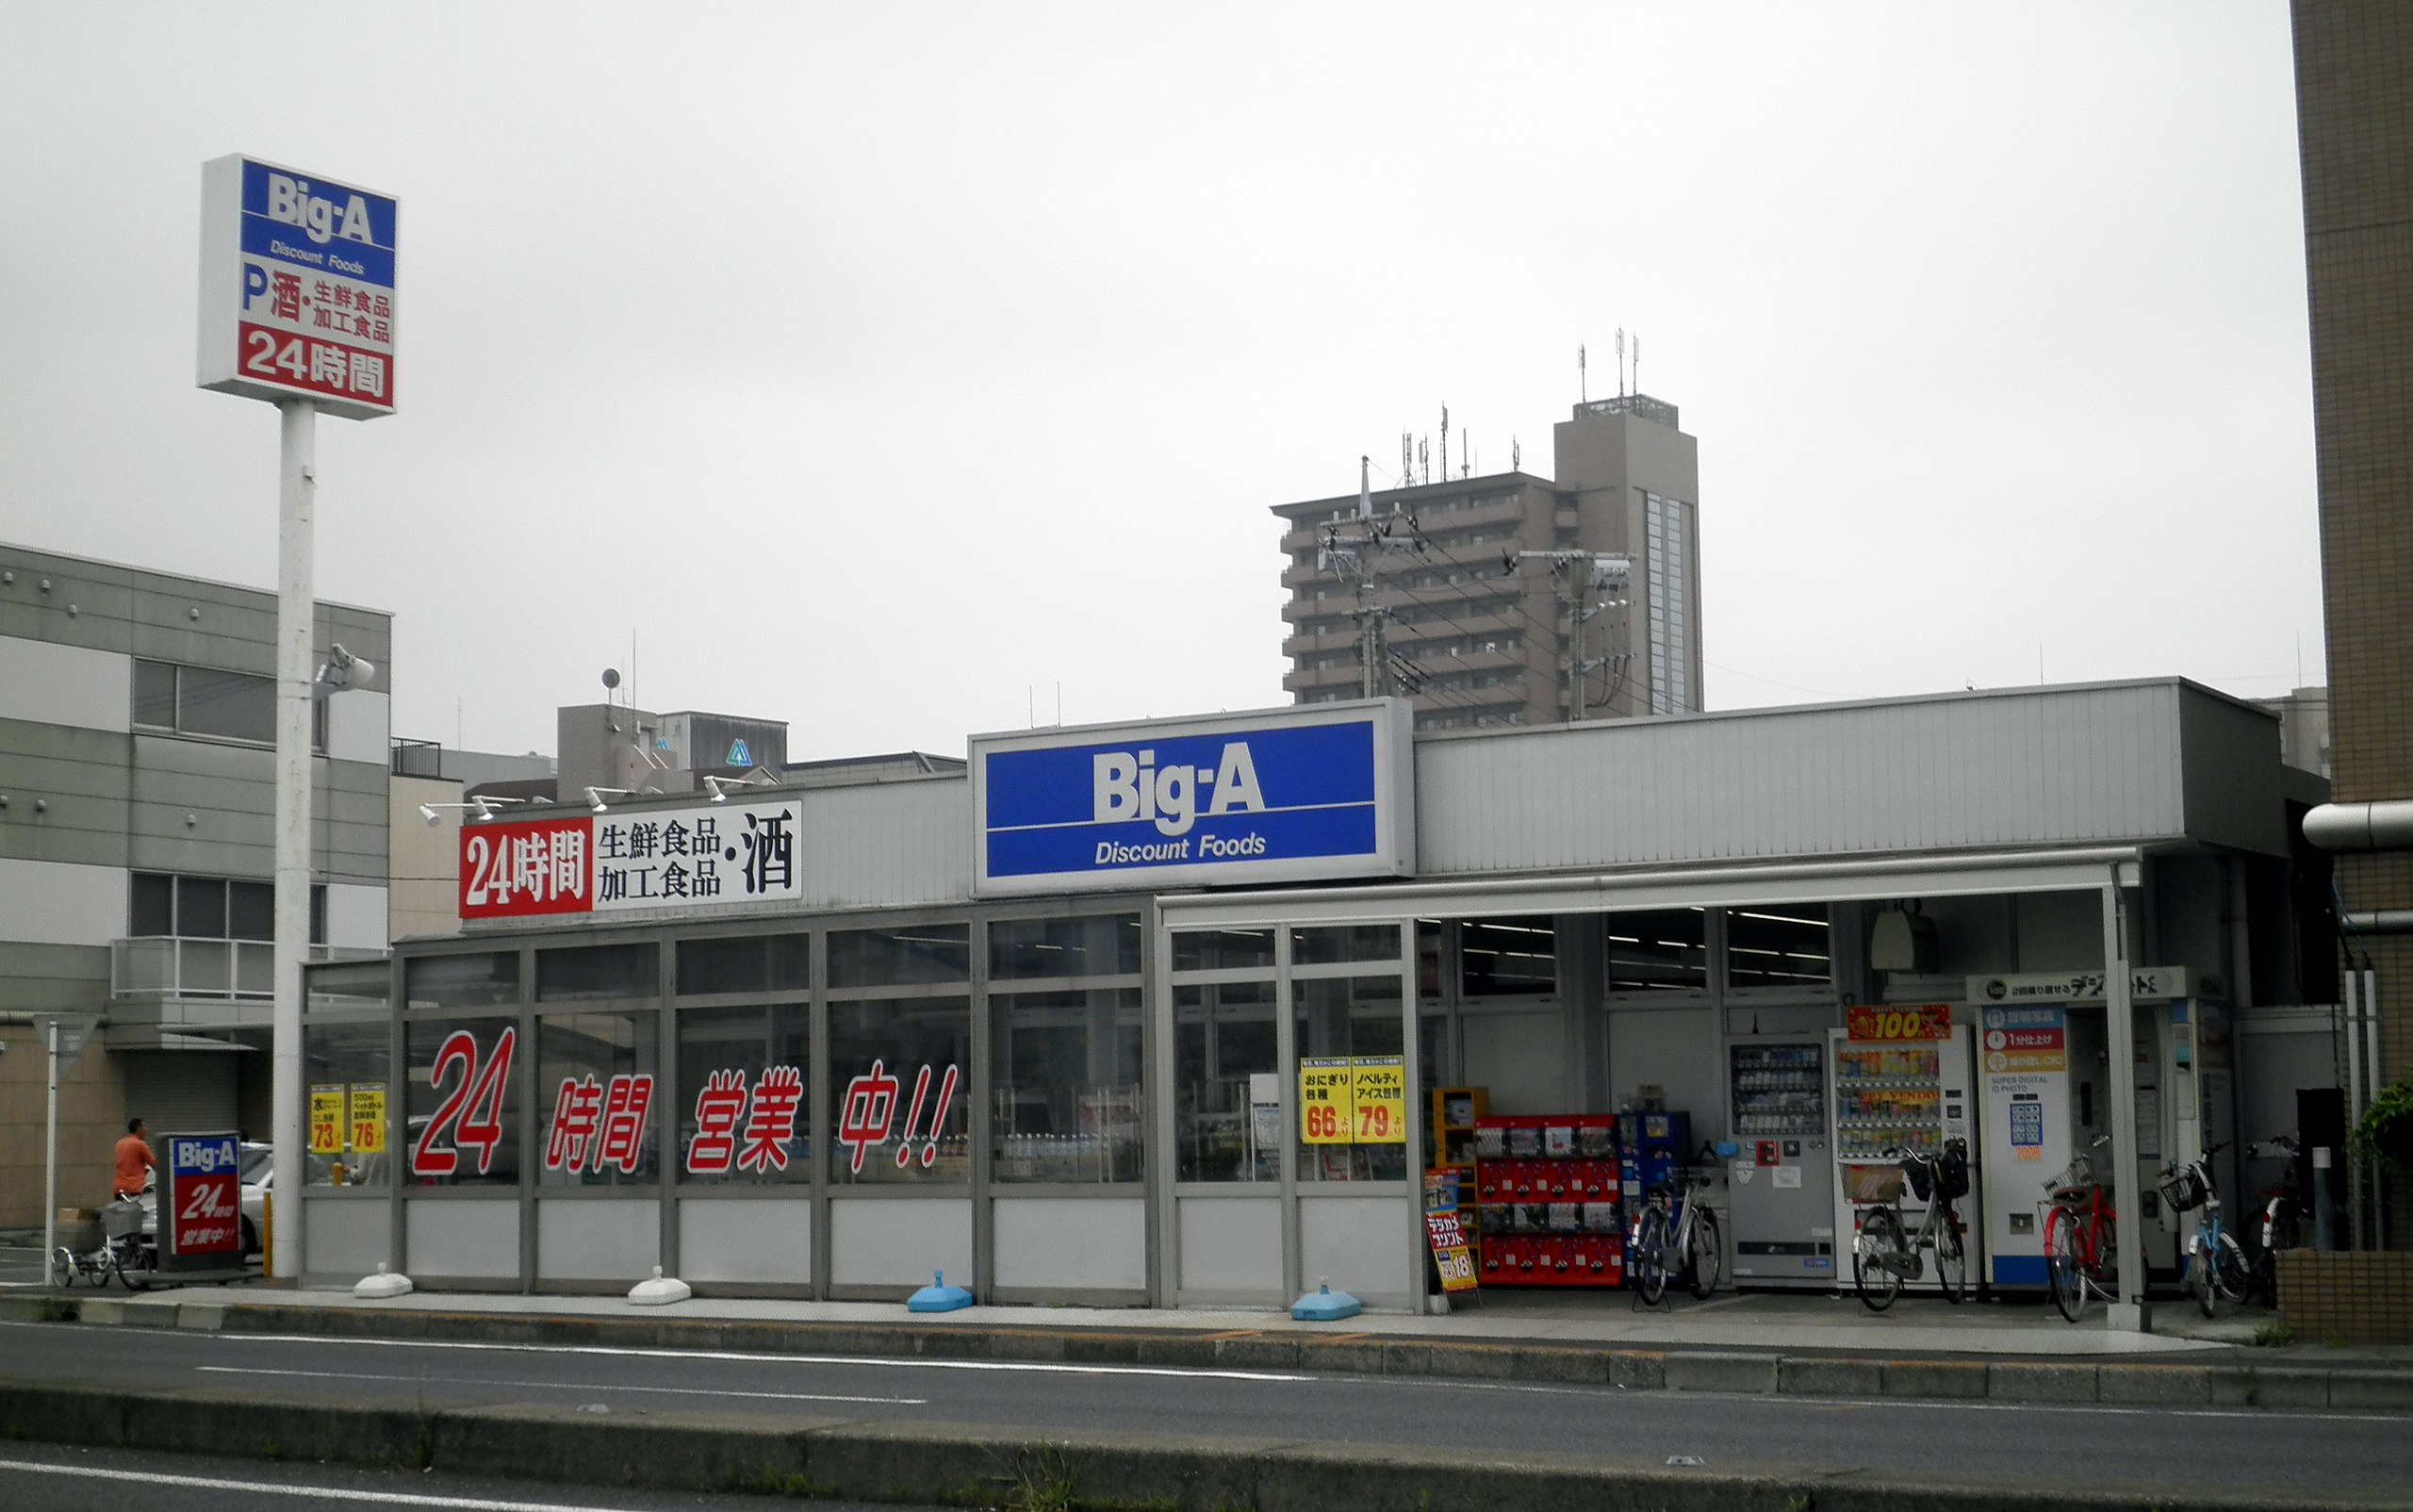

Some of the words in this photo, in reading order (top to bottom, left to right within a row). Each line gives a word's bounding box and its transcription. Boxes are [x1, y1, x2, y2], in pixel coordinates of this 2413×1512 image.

[268, 172, 372, 244] Big-A
[271, 239, 322, 265] Discount
[329, 255, 365, 276] Foods
[242, 262, 269, 310] P
[314, 280, 390, 320] 生鮮食品
[313, 305, 389, 345] 加工食品
[247, 329, 385, 398] 24時間
[1092, 741, 1266, 836] Big-A
[598, 816, 721, 860] 生鮮食品
[1095, 838, 1190, 865] Discount
[1198, 832, 1267, 859] Foods
[467, 829, 585, 906] 24時間
[598, 859, 721, 903] 加工食品
[1305, 1073, 1348, 1086] おにぎり
[1305, 1088, 1328, 1101] 各種
[1356, 1072, 1398, 1085] ノベルティ
[1357, 1087, 1402, 1100] アイス各種
[413, 1026, 515, 1175] 24
[546, 1073, 653, 1175] 時間
[687, 1065, 803, 1175] 営業
[315, 1124, 333, 1148] 73
[354, 1122, 373, 1147] 76
[1307, 1105, 1336, 1138] 66
[1358, 1104, 1388, 1138] 79
[178, 1141, 236, 1172] Big-A
